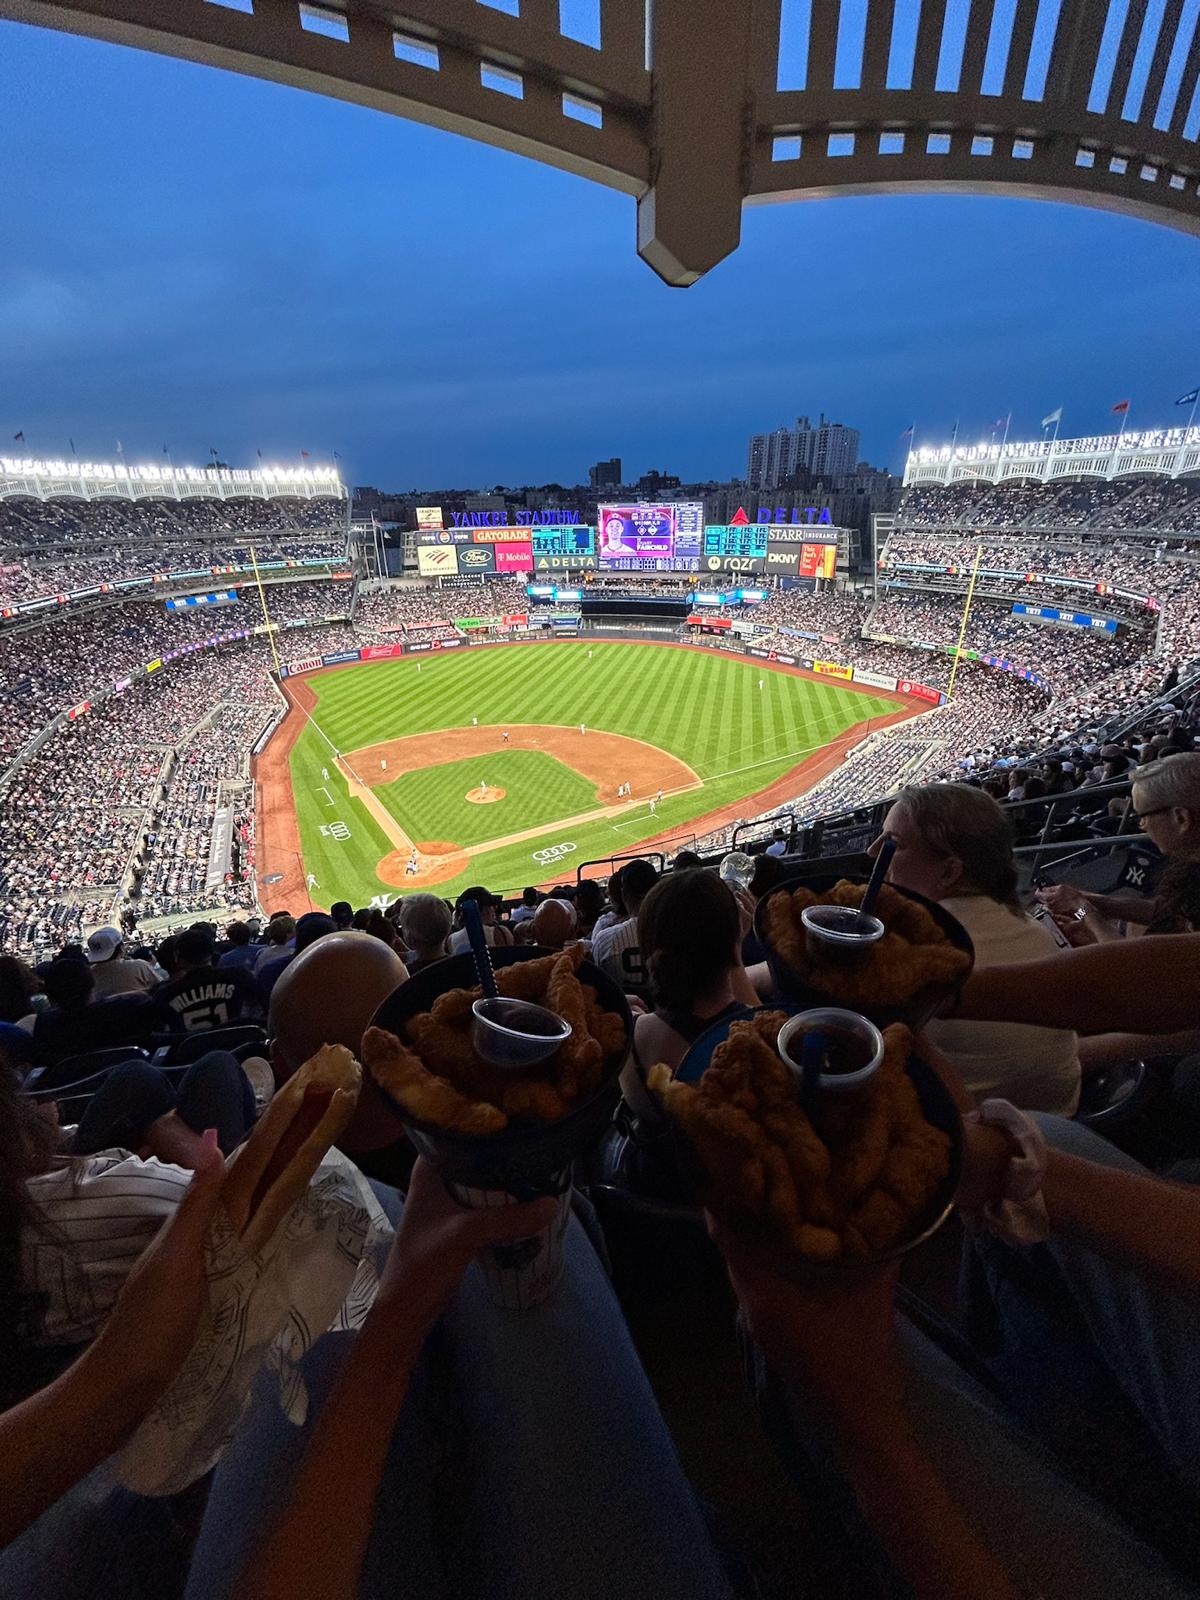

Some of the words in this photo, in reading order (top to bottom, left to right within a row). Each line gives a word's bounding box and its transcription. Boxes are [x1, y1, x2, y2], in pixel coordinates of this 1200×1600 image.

[450, 511, 508, 528] YANKEE
[515, 510, 579, 526] STADIUM
[757, 506, 832, 525] DELTA
[477, 530, 529, 541] GATORADE
[768, 528, 803, 540] STARR
[466, 551, 487, 561] Ford
[506, 552, 531, 561] Mobile
[768, 553, 798, 564] DKNY
[552, 557, 595, 567] DELTA
[723, 557, 758, 571] razr
[1025, 607, 1041, 615] YETI
[1060, 612, 1074, 621] YETI
[1091, 618, 1107, 628] YETI
[289, 659, 320, 673] Canon
[541, 855, 565, 866] Audi
[169, 984, 235, 1013] WILLIAMS
[183, 1003, 228, 1031] 51
